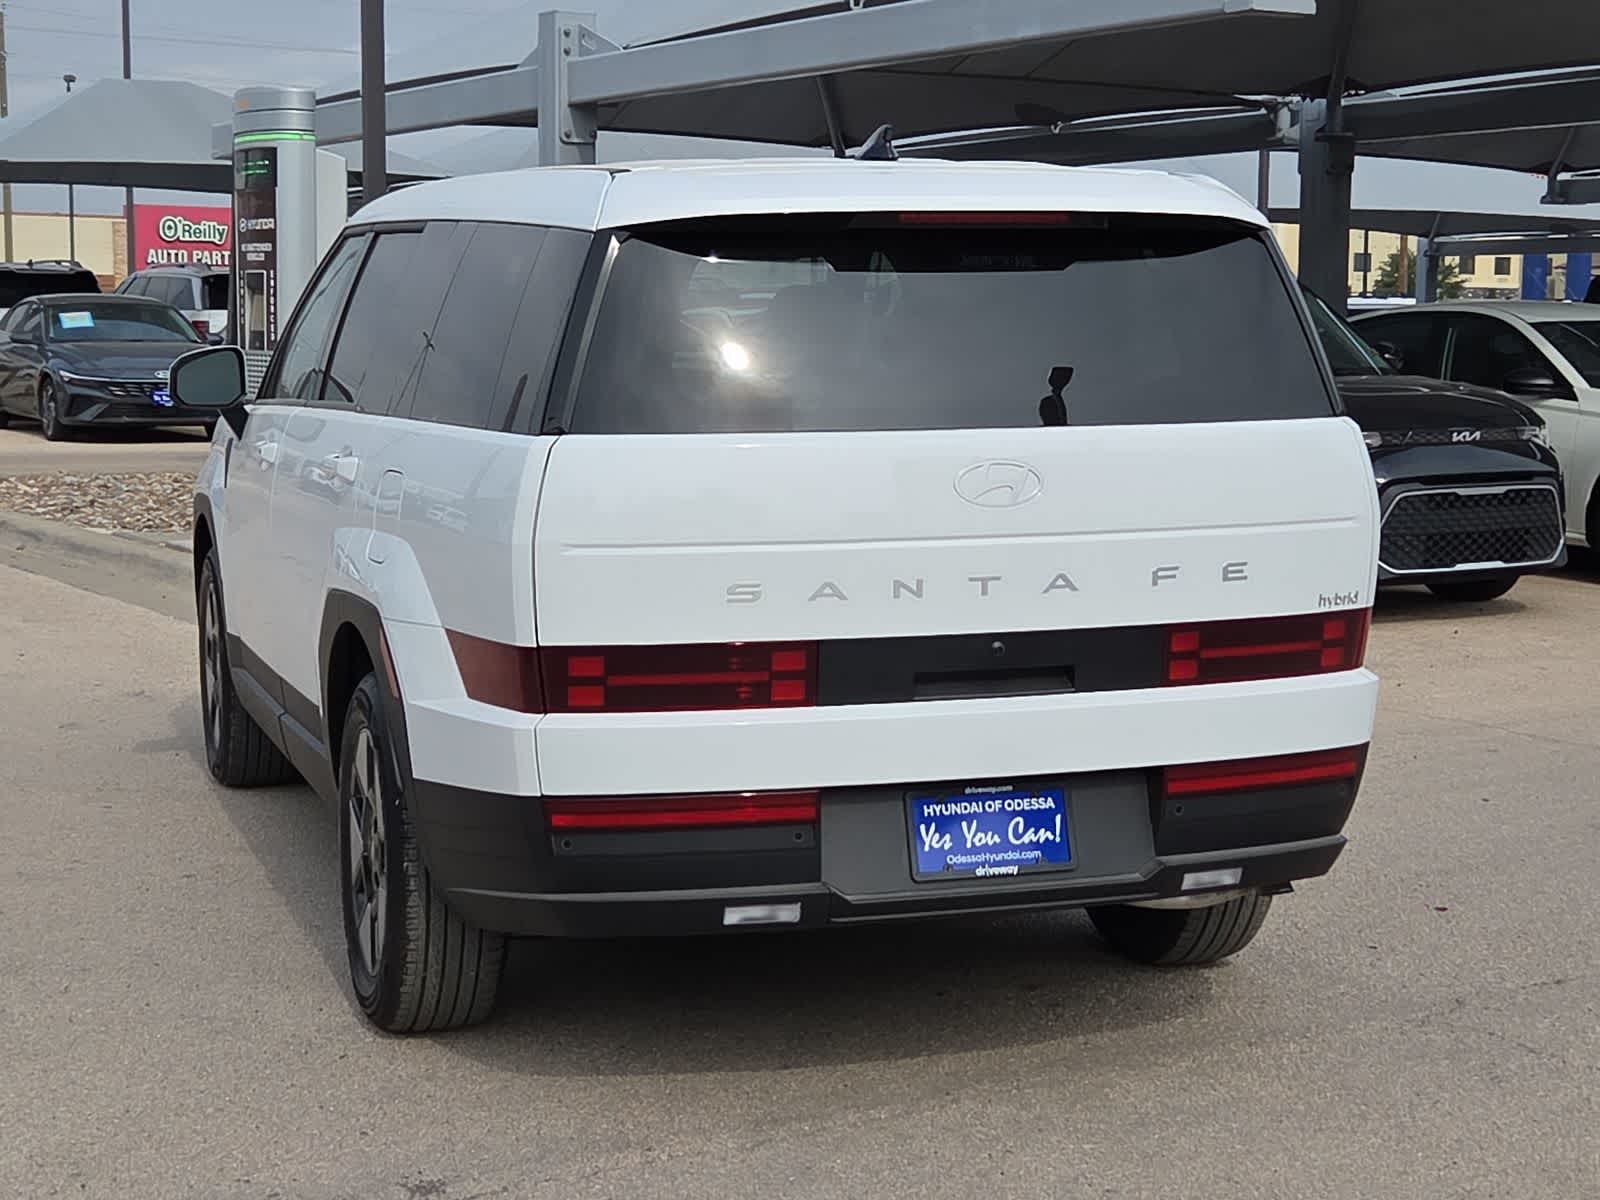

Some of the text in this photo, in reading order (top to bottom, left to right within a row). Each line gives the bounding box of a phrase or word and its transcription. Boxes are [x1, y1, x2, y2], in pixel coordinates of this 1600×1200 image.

[160, 216, 228, 244] O'Reilly
[147, 249, 188, 264] AUTO
[192, 250, 231, 265] PART
[726, 561, 1248, 603] SANTA FE
[1318, 591, 1359, 608] hybrid
[923, 797, 1055, 817] HYUNDAI OF ODESSA
[920, 814, 1061, 852] Yes You Can!
[946, 850, 1042, 865] OdessaHyundai.com
[975, 864, 1019, 877] driveway
